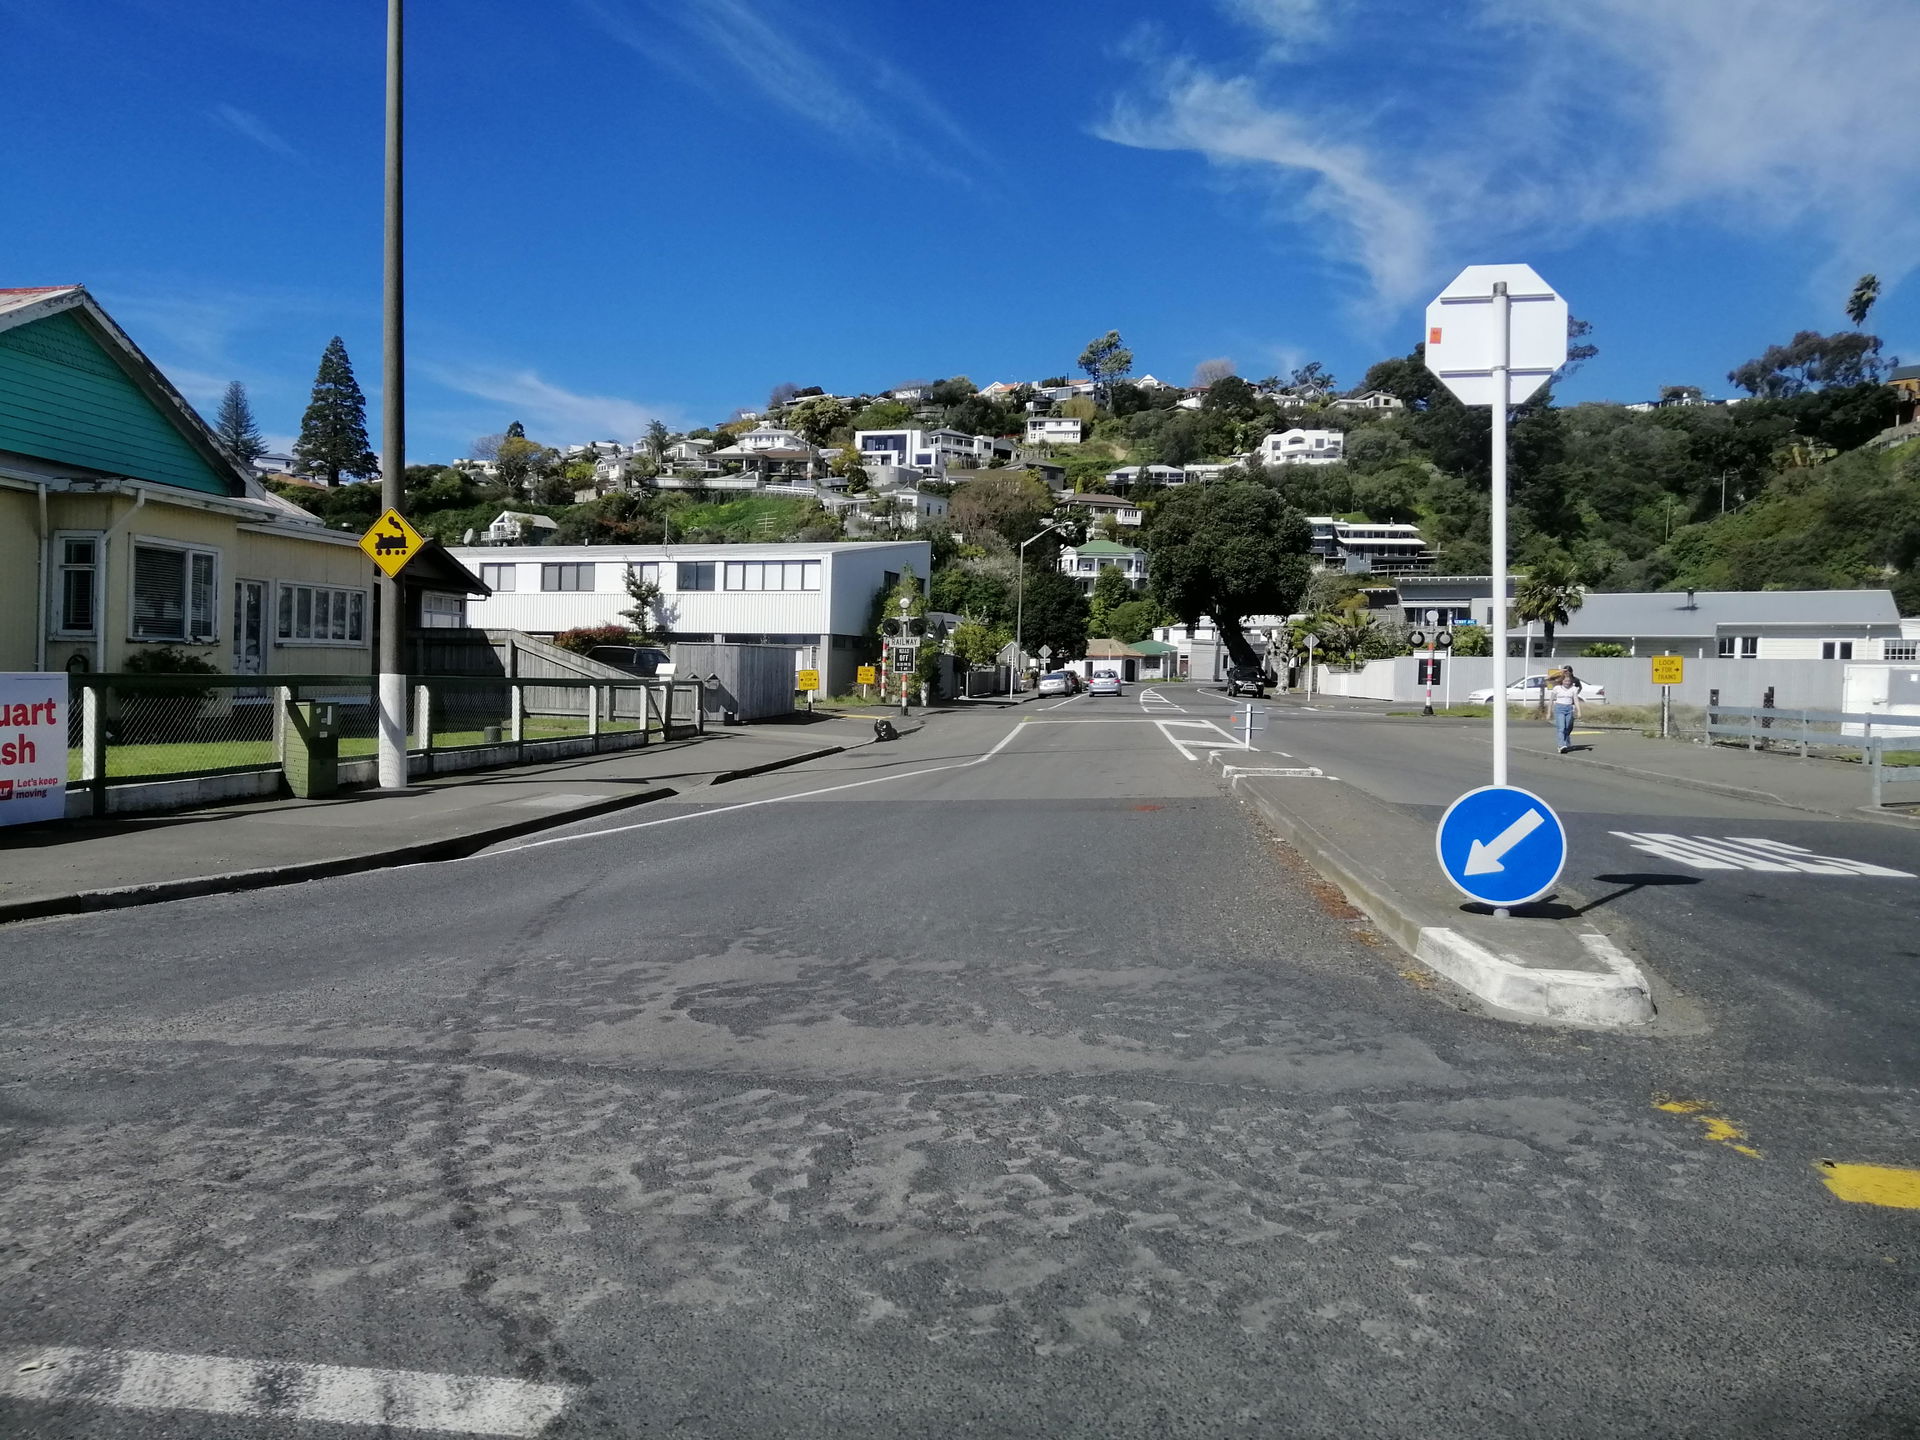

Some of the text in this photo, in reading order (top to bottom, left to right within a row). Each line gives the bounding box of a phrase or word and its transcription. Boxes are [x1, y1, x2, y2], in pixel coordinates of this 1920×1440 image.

[892, 638, 917, 646] RAILWAY
[0, 698, 56, 726] uart
[0, 733, 35, 765] sh
[17, 777, 58, 787] Let's keep
[16, 789, 47, 799] moving
